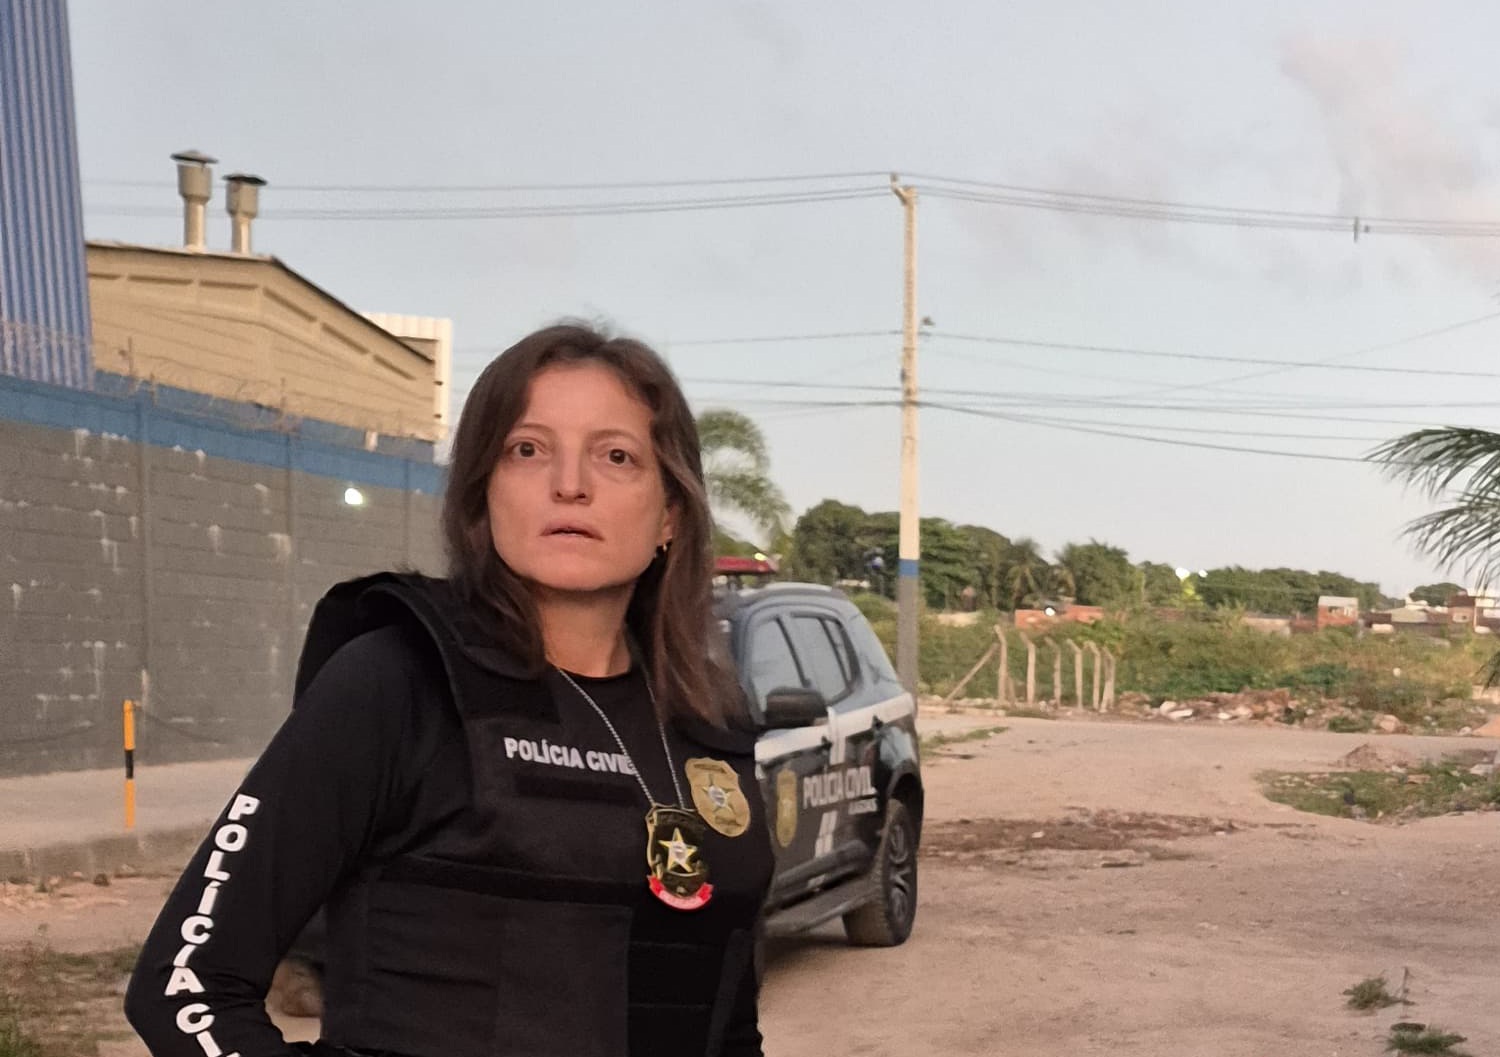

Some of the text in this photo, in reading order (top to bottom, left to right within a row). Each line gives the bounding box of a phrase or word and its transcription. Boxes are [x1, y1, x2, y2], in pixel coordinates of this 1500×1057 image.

[504, 736, 638, 776] POLÍCIA CIVIL
[165, 793, 260, 996] POLÍCIA
